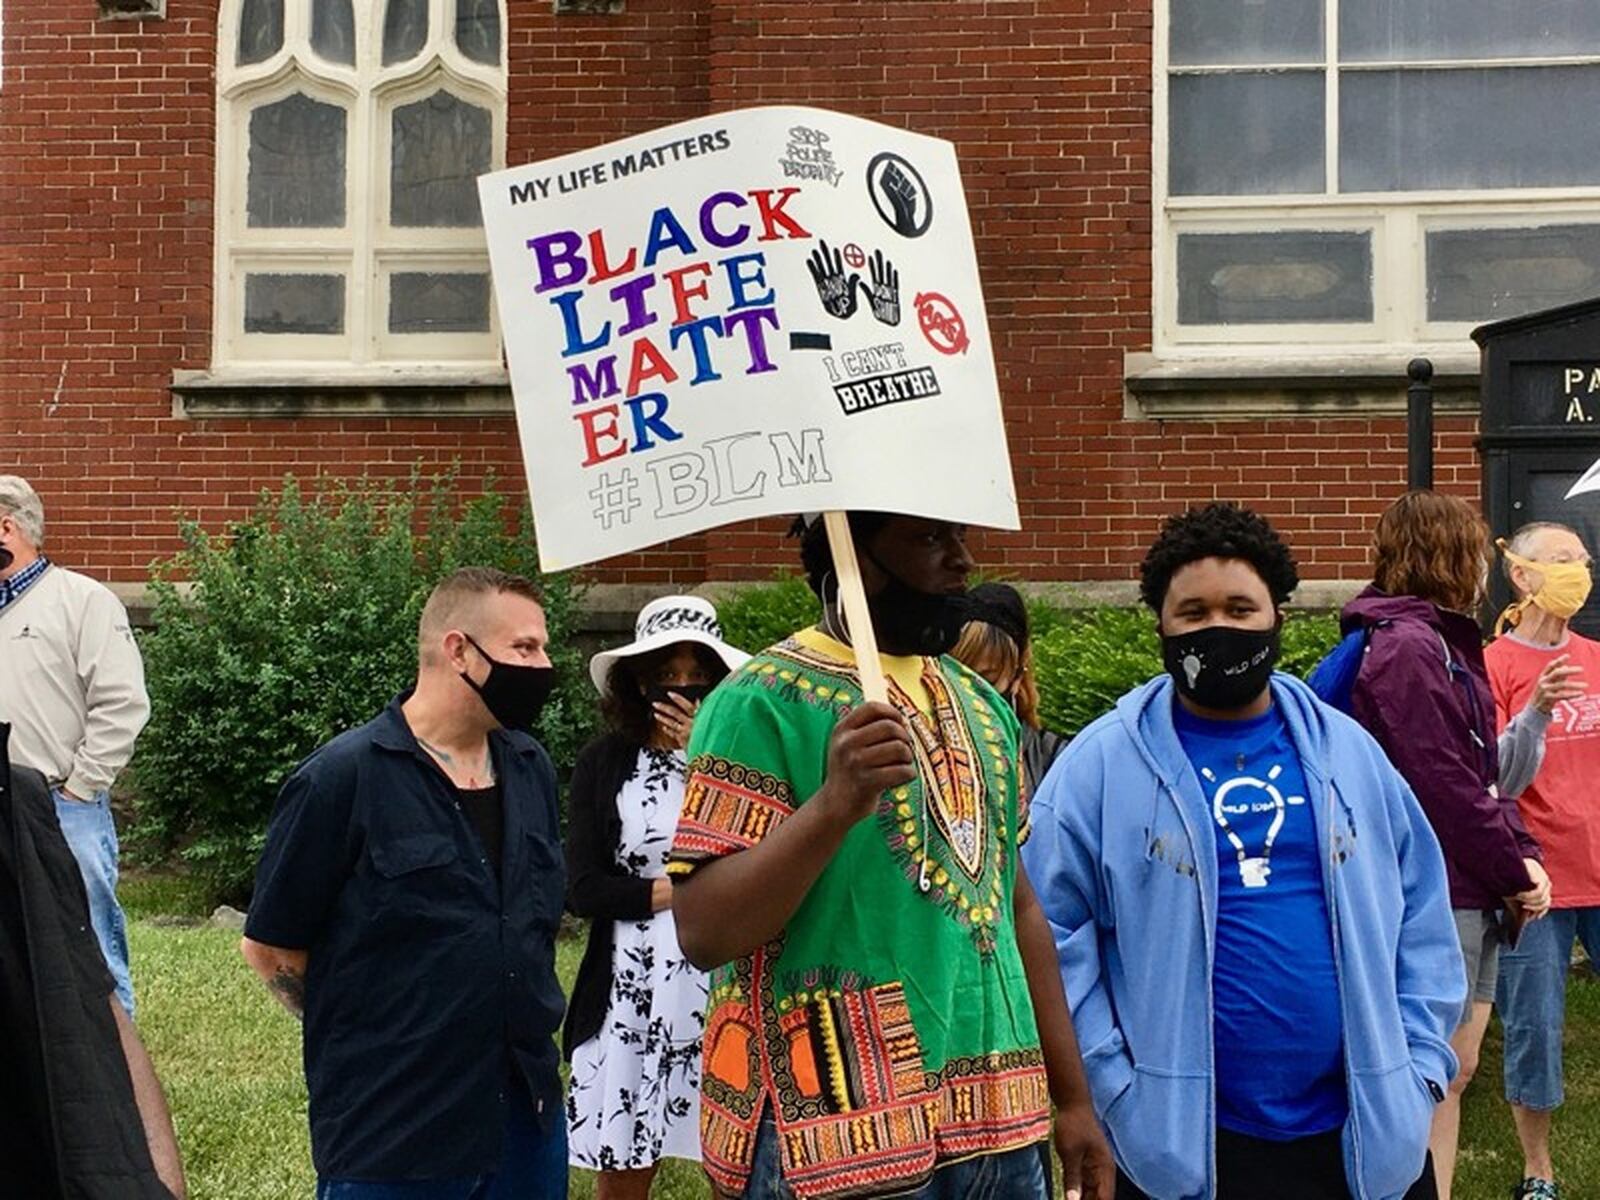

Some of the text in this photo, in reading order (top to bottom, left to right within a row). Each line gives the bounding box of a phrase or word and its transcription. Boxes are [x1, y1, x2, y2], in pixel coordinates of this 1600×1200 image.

[509, 129, 731, 205] MY LIFE MATTERS
[526, 187, 812, 294] BLACK
[550, 252, 776, 357] LIFE
[823, 342, 907, 382] I CAN'T
[837, 369, 938, 412] BREATHE
[573, 392, 683, 468] ER
[589, 429, 832, 530] #BLM
